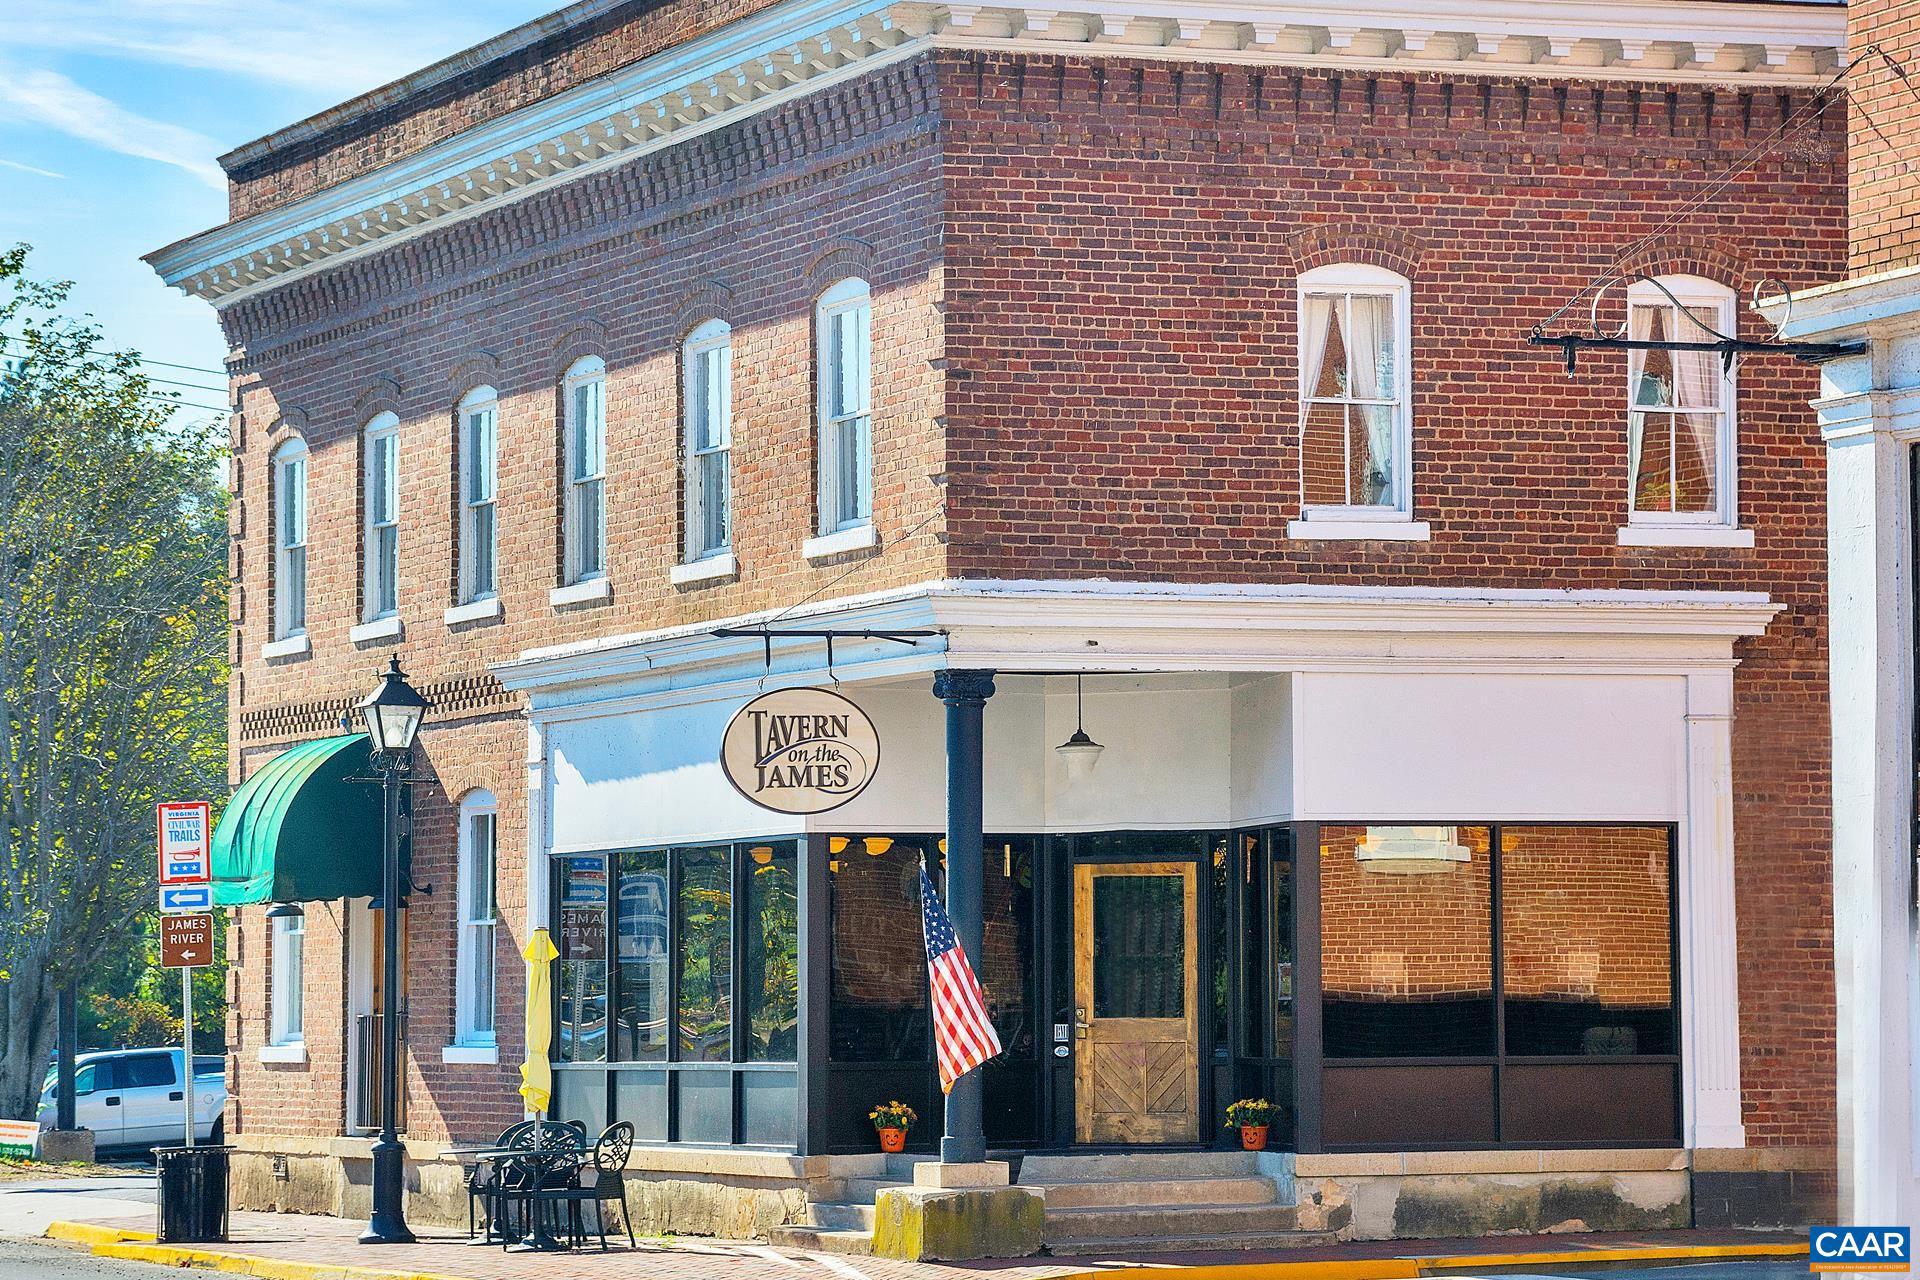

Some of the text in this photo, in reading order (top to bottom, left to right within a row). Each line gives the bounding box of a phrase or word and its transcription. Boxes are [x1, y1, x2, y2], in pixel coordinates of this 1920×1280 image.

[747, 709, 850, 768] TAVERN
[788, 743, 840, 763] on the
[754, 764, 850, 793] JAMES
[168, 820, 200, 829] CIVIL WAR
[168, 829, 201, 842] TRAILS
[167, 918, 207, 931] JAMES
[170, 933, 204, 945] RIVER
